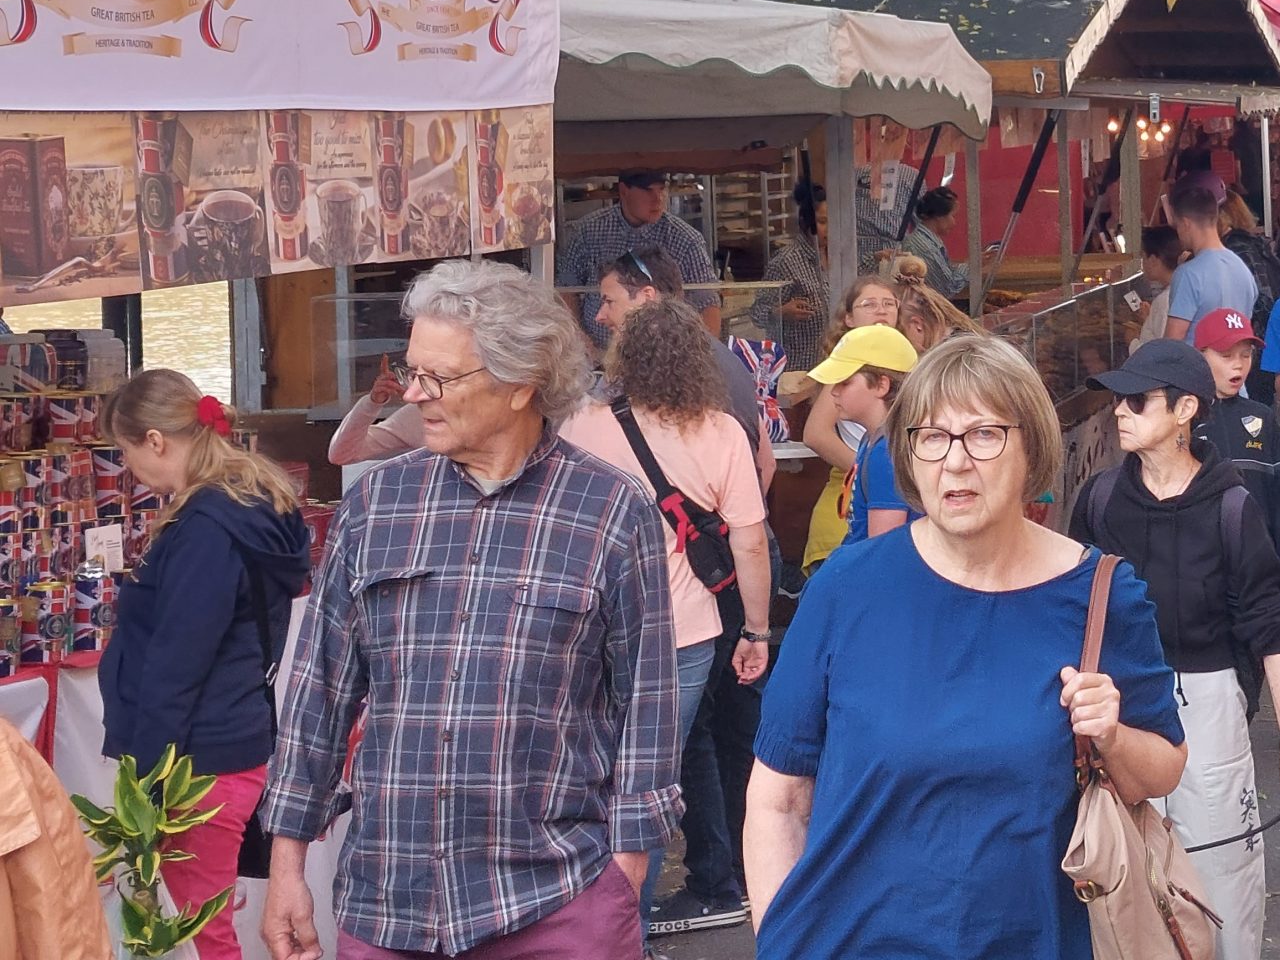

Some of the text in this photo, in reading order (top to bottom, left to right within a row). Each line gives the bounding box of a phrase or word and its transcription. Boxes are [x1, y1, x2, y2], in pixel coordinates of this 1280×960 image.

[90, 7, 155, 22] GREAT BRITISH TEA
[416, 21, 431, 32] GREAT
[95, 39, 153, 50] HERITAGE & TRADITION
[1225, 313, 1244, 329] NY
[649, 920, 690, 932] crocs
